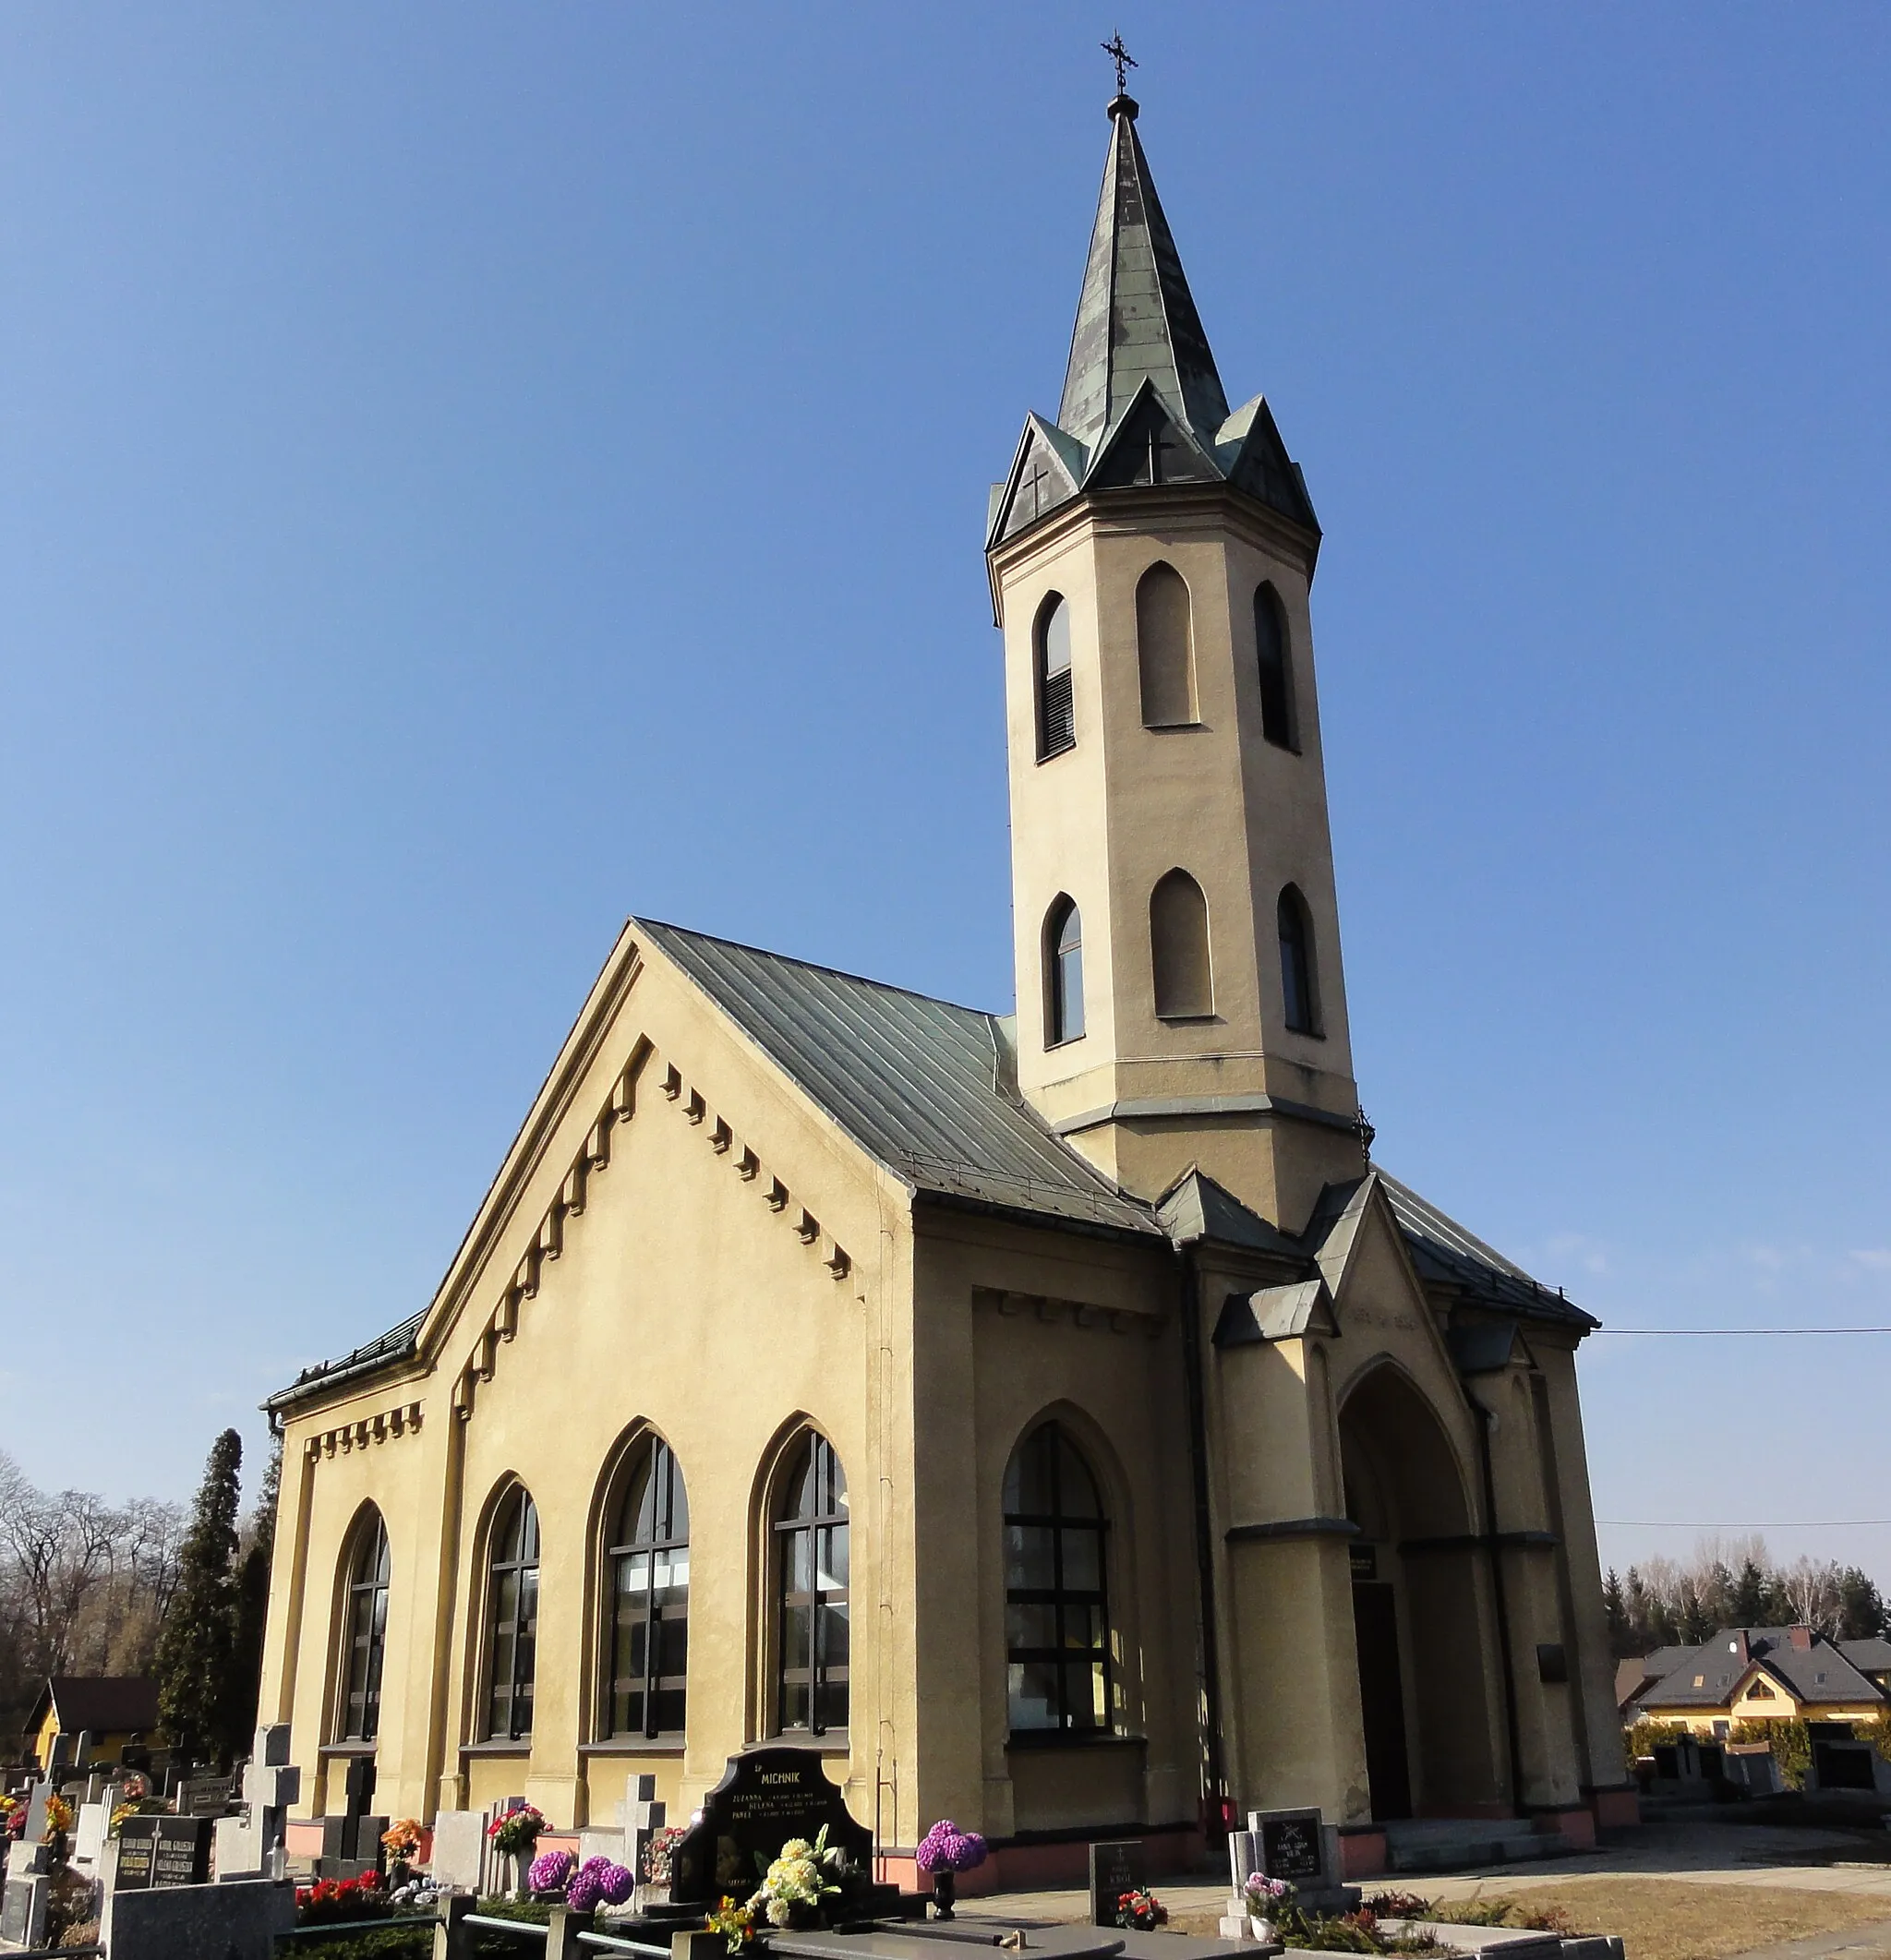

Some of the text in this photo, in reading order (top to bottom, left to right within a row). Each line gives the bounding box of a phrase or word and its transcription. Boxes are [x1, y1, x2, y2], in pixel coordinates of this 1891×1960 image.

[761, 1772, 801, 1785] MICHNIK
[732, 1794, 763, 1803] ZUZANNA
[749, 1801, 775, 1810] HELENA
